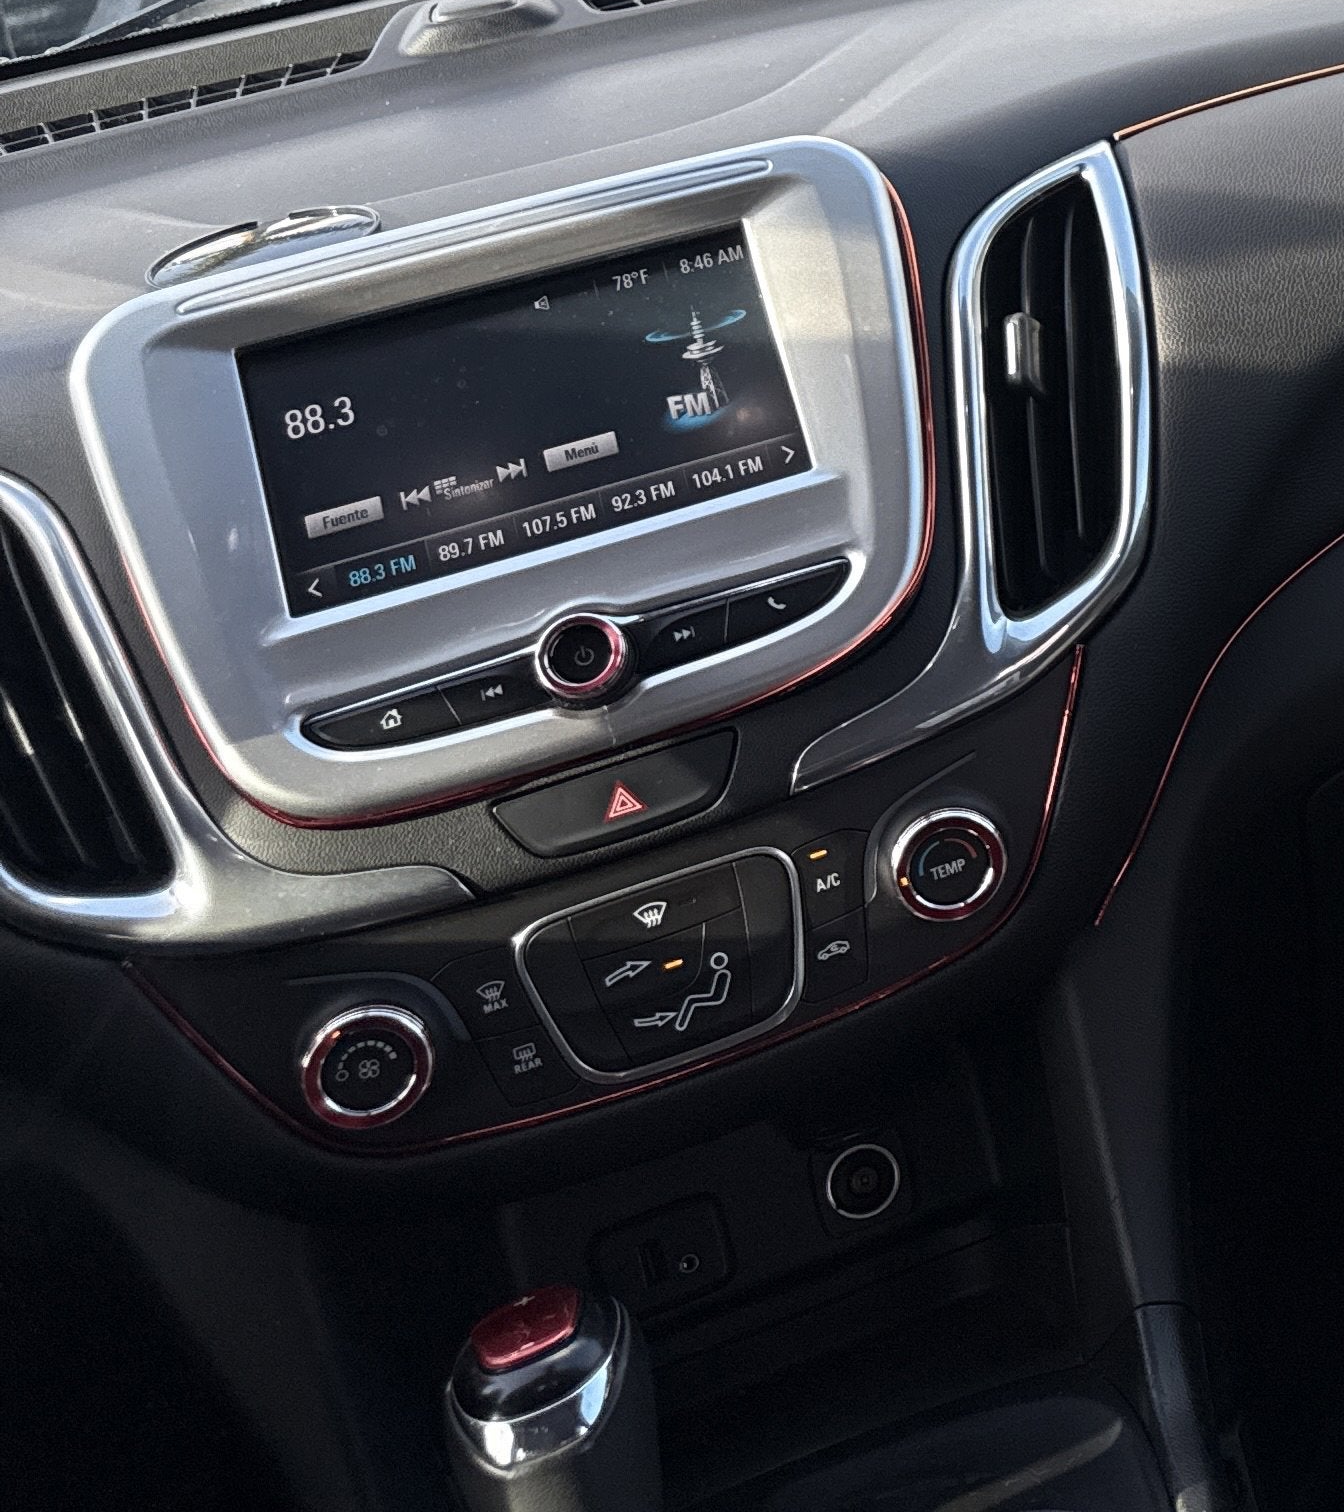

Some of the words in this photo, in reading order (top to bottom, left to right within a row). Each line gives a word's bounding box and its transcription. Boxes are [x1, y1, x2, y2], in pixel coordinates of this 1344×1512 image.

[679, 250, 714, 276] 8:46
[716, 245, 746, 267] AM
[612, 268, 651, 292] 78°F
[284, 396, 356, 441] 88.3
[666, 393, 711, 420] FM
[565, 441, 600, 462] Menú
[692, 464, 735, 491] 104.1
[738, 457, 764, 479] FM
[611, 489, 648, 514] 92.3
[650, 482, 676, 503] FM
[322, 505, 370, 531] Fuente
[522, 511, 567, 539] 107.5
[570, 504, 597, 527] FM
[438, 537, 475, 563] 89.7
[478, 529, 505, 553] FM
[348, 559, 387, 588] 88.3
[390, 555, 417, 578] FM
[930, 855, 968, 880] TEMP
[816, 872, 843, 894] A/C
[483, 996, 510, 1015] MAX
[514, 1056, 546, 1076] REAR
